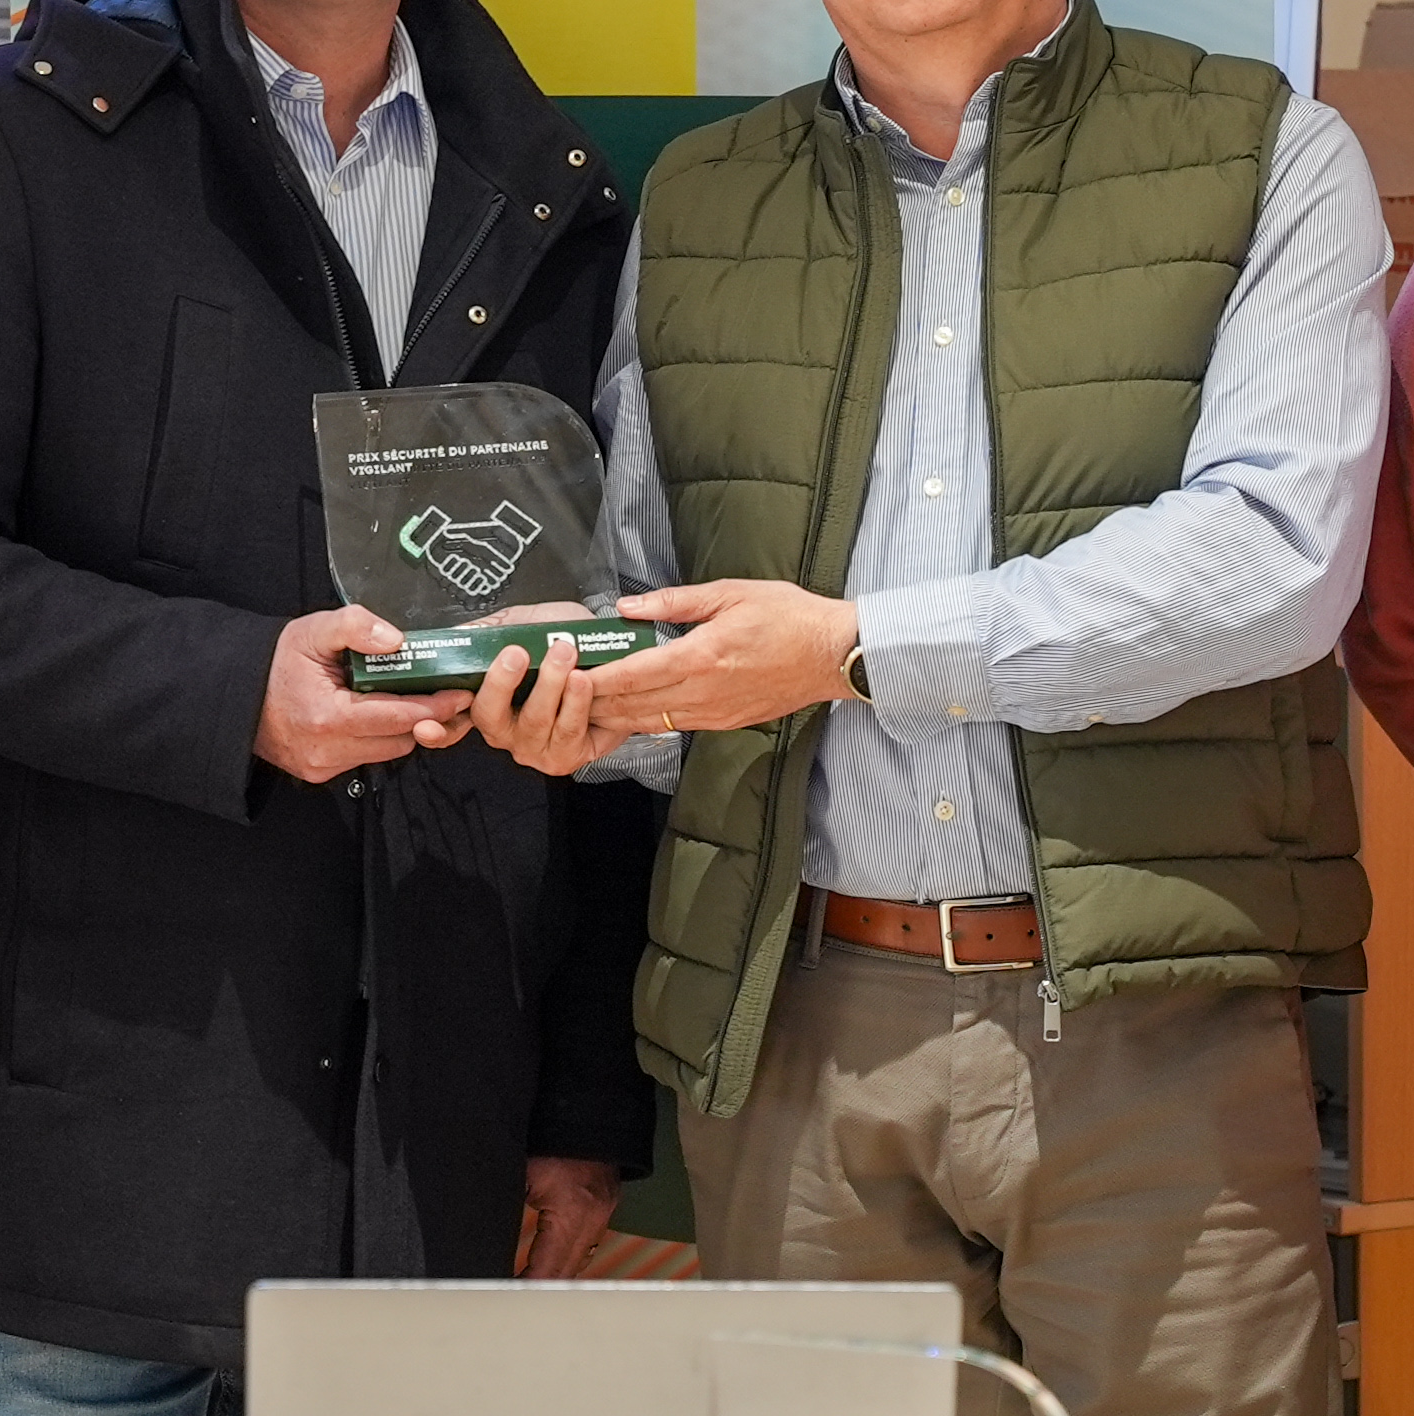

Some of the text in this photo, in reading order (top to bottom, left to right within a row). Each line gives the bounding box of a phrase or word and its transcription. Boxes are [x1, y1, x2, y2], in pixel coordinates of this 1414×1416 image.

[348, 440, 549, 463] PRIX SÉCURITÉ DU PARTENAIRE
[349, 462, 413, 476] VIGILANT
[410, 637, 472, 650] PARTENAIRE
[577, 631, 636, 653] Heidelberg Materials
[365, 661, 412, 673] Blanchard
